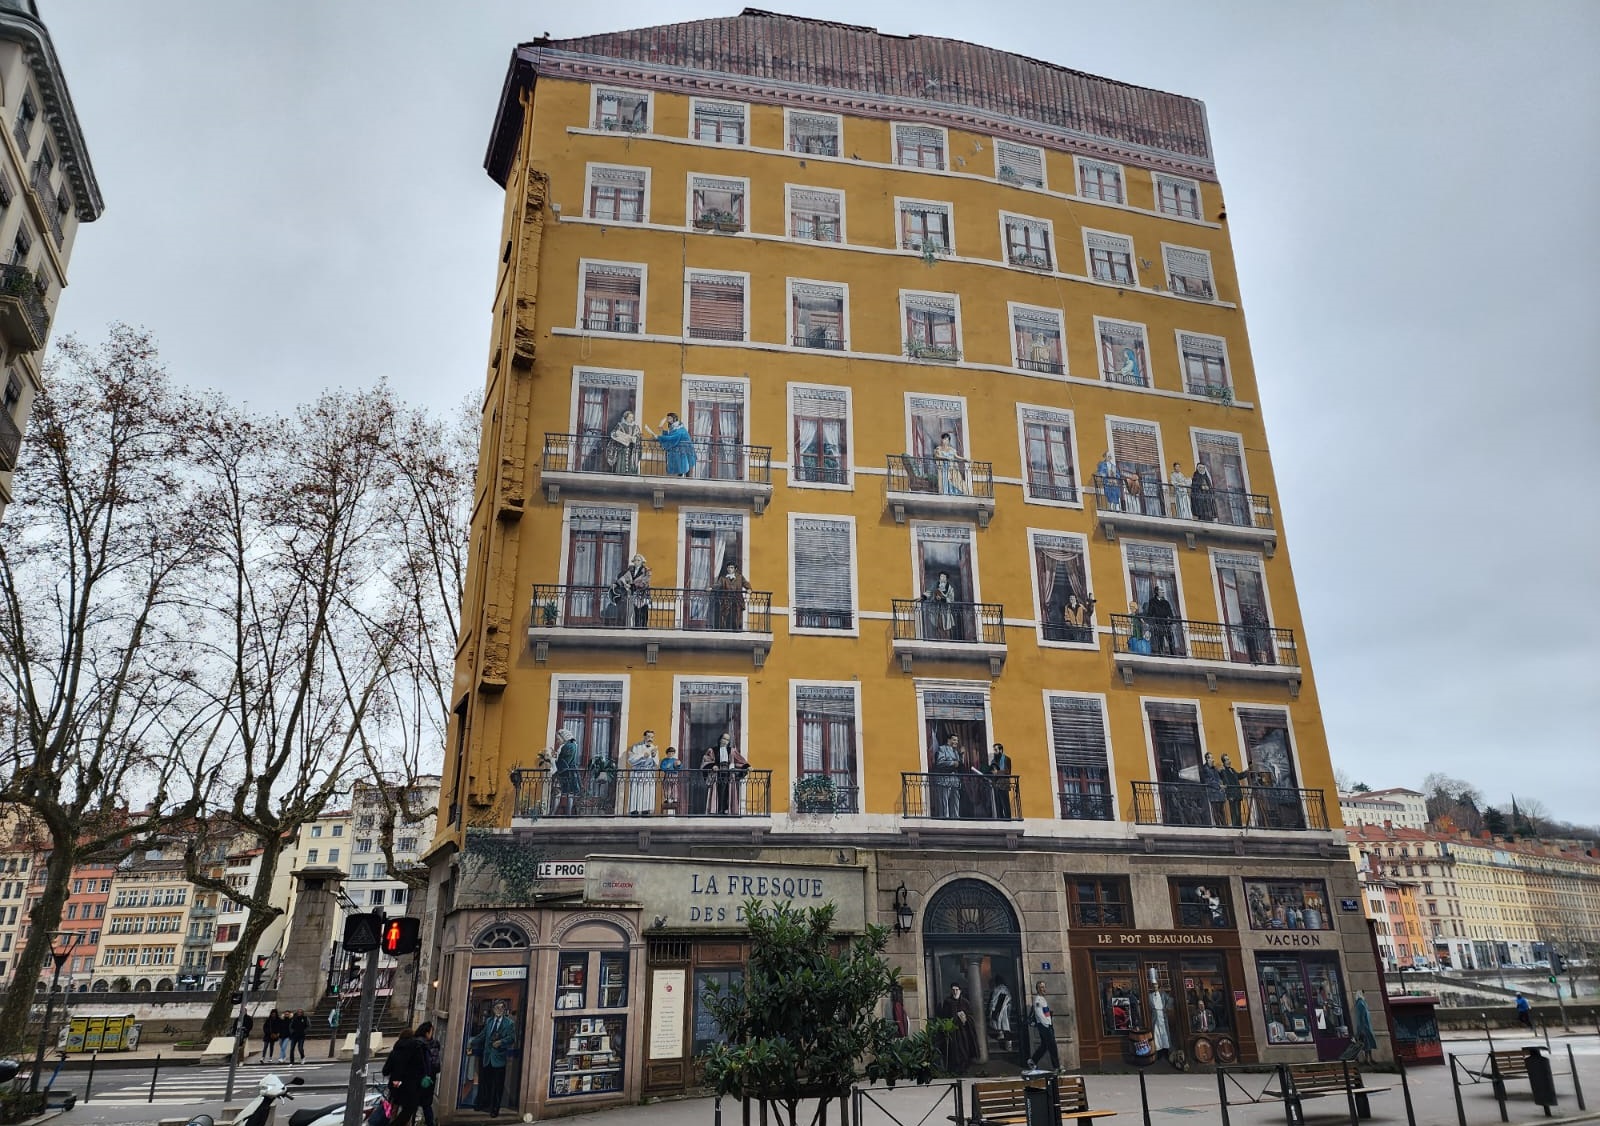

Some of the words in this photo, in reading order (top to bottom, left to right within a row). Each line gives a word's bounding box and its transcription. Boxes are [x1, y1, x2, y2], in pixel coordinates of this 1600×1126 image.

[538, 864, 551, 875] LE
[691, 874, 719, 895] LA
[727, 875, 823, 899] FRESQUE
[690, 906, 726, 922] DES
[1098, 934, 1113, 944] LE
[1119, 934, 1142, 944] POT
[1148, 934, 1214, 944] BEAUJOLAIS
[1265, 934, 1320, 946] VACHON
